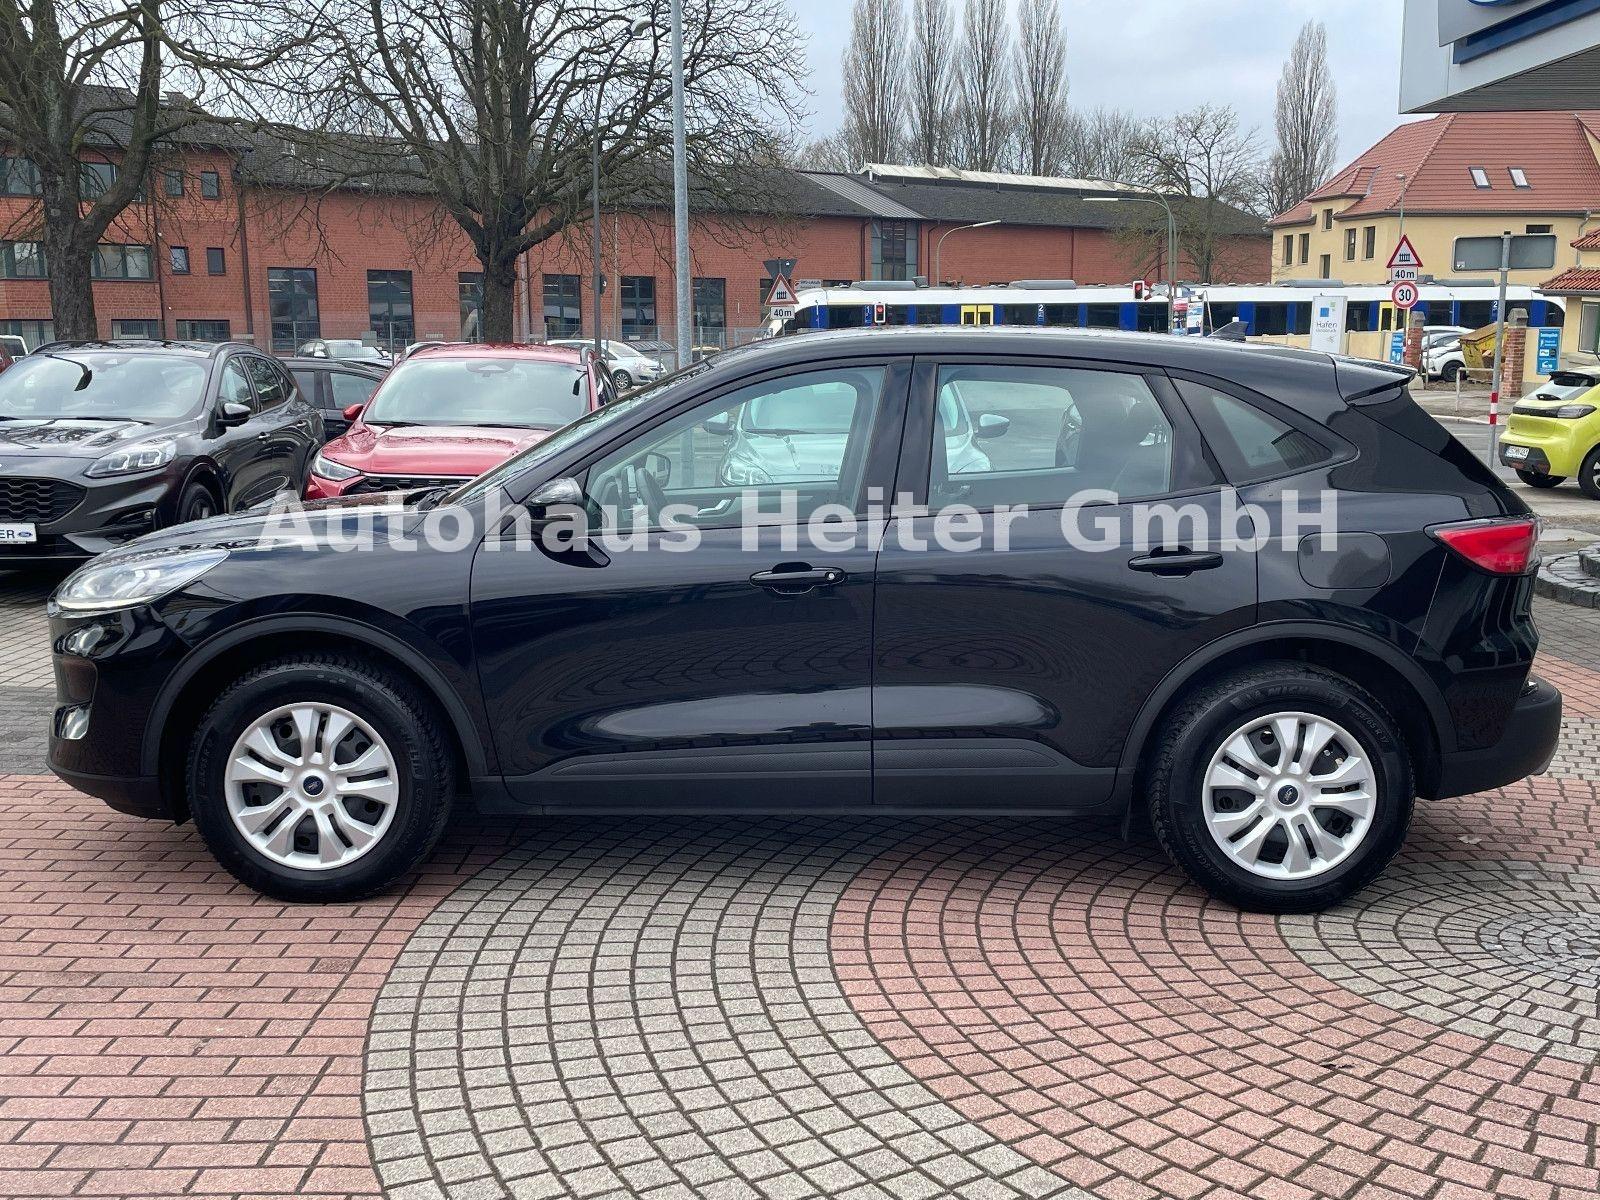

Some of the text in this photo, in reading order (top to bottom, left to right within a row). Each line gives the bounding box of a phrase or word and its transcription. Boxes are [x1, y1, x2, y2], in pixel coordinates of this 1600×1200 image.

[1398, 289, 1411, 301] 30
[1493, 300, 1498, 308] 2
[1316, 320, 1337, 328] Hafen
